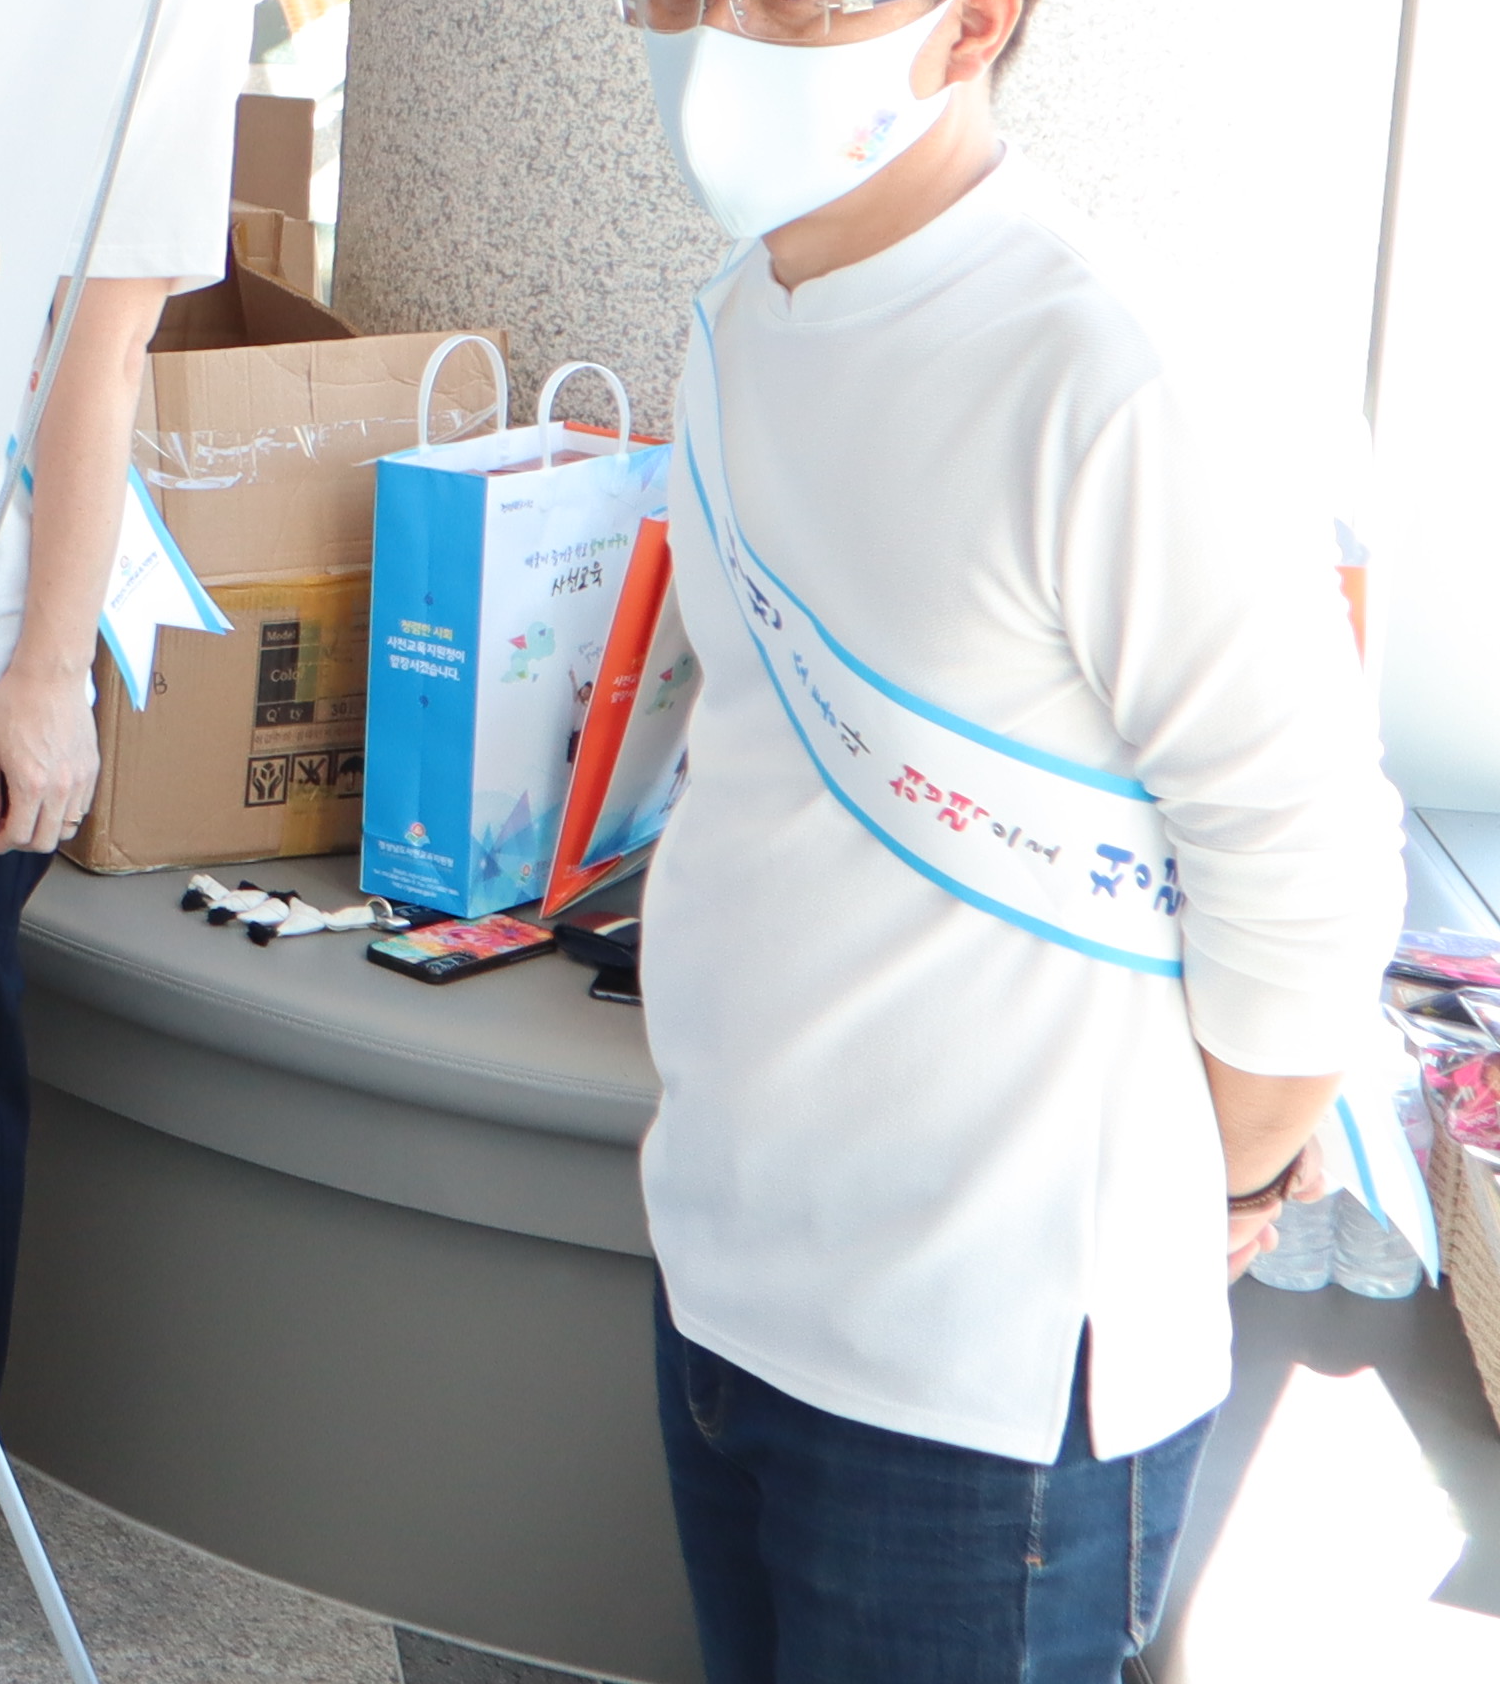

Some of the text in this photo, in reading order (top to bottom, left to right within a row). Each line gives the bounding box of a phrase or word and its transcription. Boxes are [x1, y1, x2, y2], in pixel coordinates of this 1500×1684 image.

[551, 560, 604, 598] 사천교육
[266, 629, 297, 642] Model
[386, 635, 466, 665] 사천교육지원청이
[153, 671, 168, 695] B
[270, 668, 303, 683] Colo
[887, 763, 1064, 865] 협력으로
